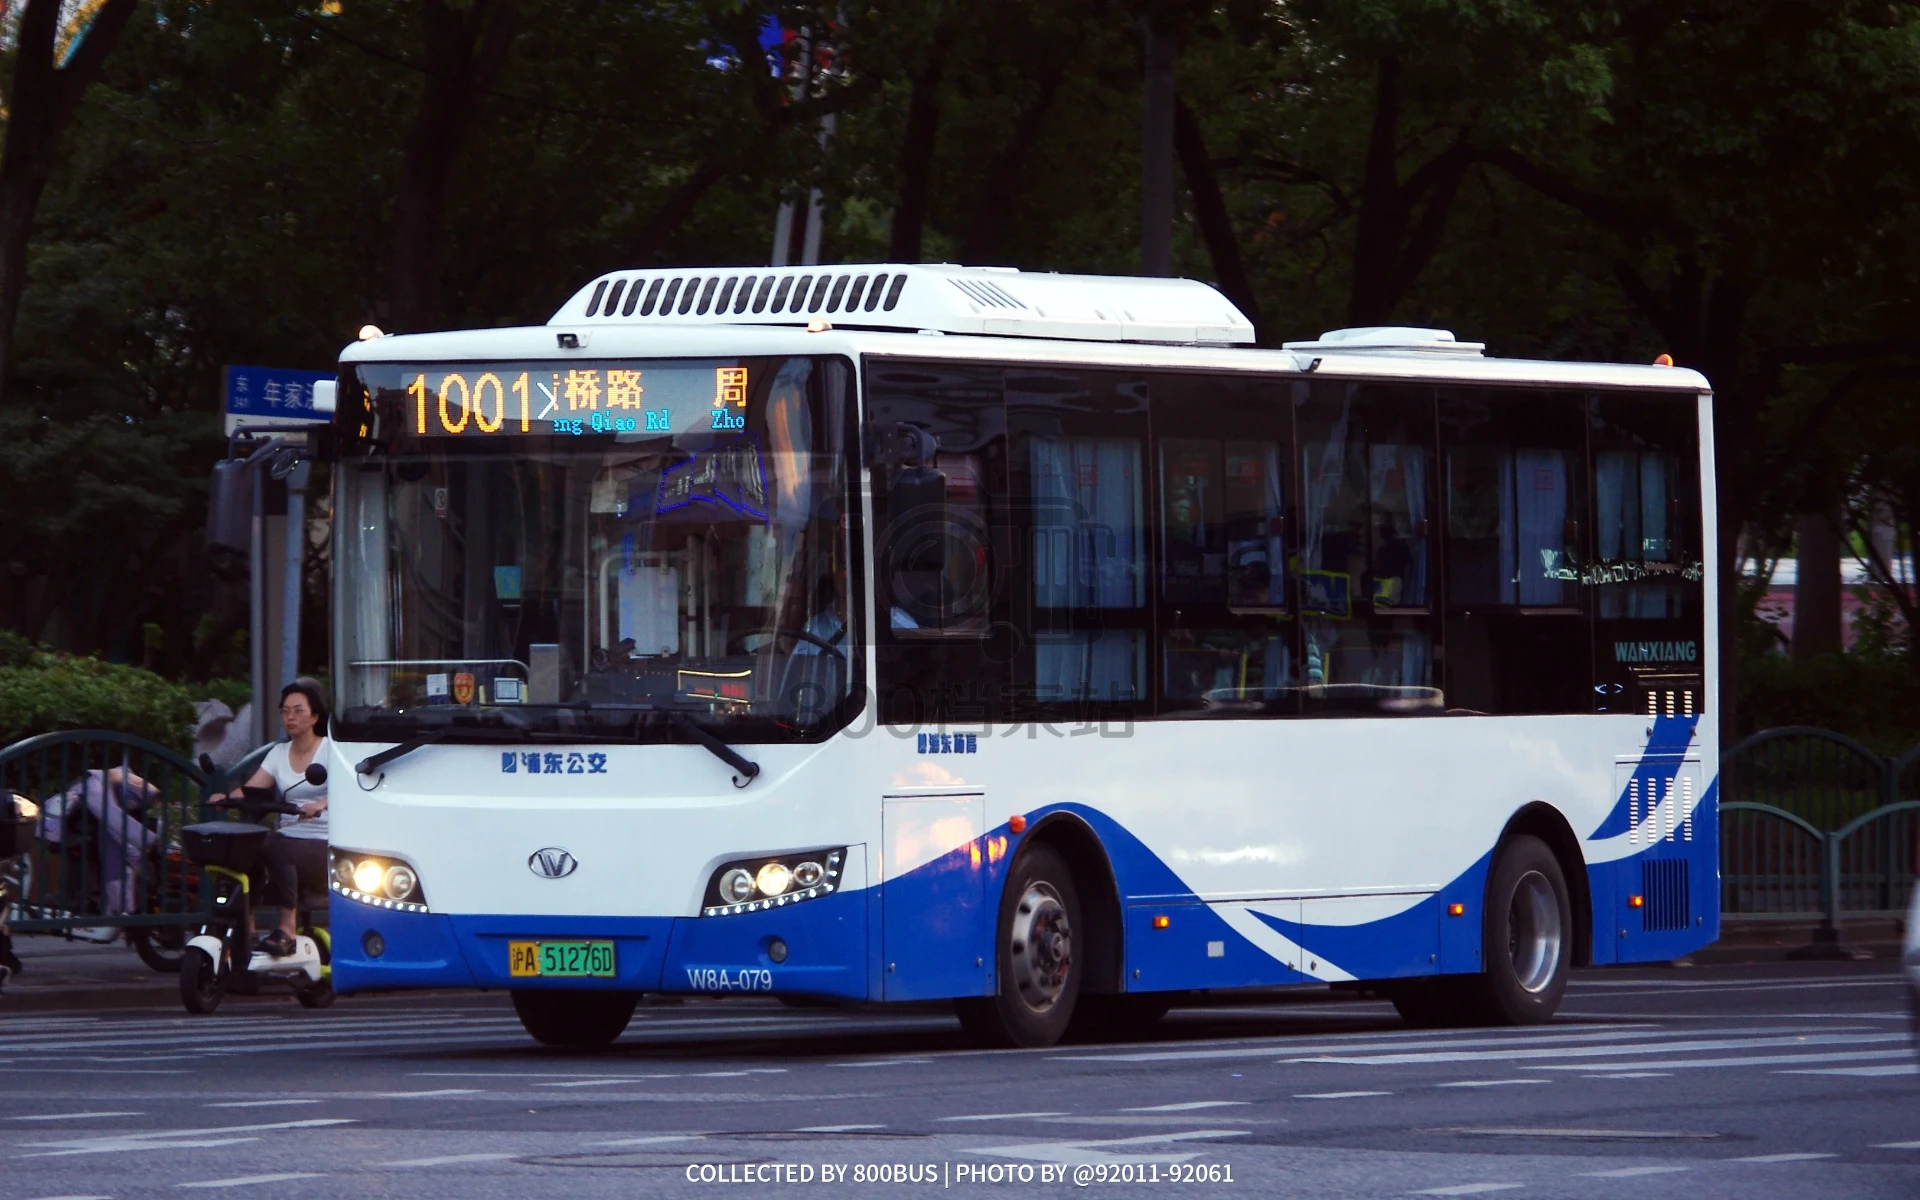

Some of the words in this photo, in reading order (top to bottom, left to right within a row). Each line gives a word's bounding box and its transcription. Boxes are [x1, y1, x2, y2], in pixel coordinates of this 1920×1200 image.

[553, 369, 643, 411] 桥路
[713, 367, 748, 408] 周
[408, 372, 530, 434] 1001
[591, 410, 637, 433] Qiao
[645, 409, 671, 431] Rd
[711, 408, 745, 429] Zho
[1614, 640, 1697, 663] WANXIANG
[521, 752, 607, 774] 浦东公交
[545, 946, 612, 972] 51276D
[686, 968, 773, 991] W8A-079
